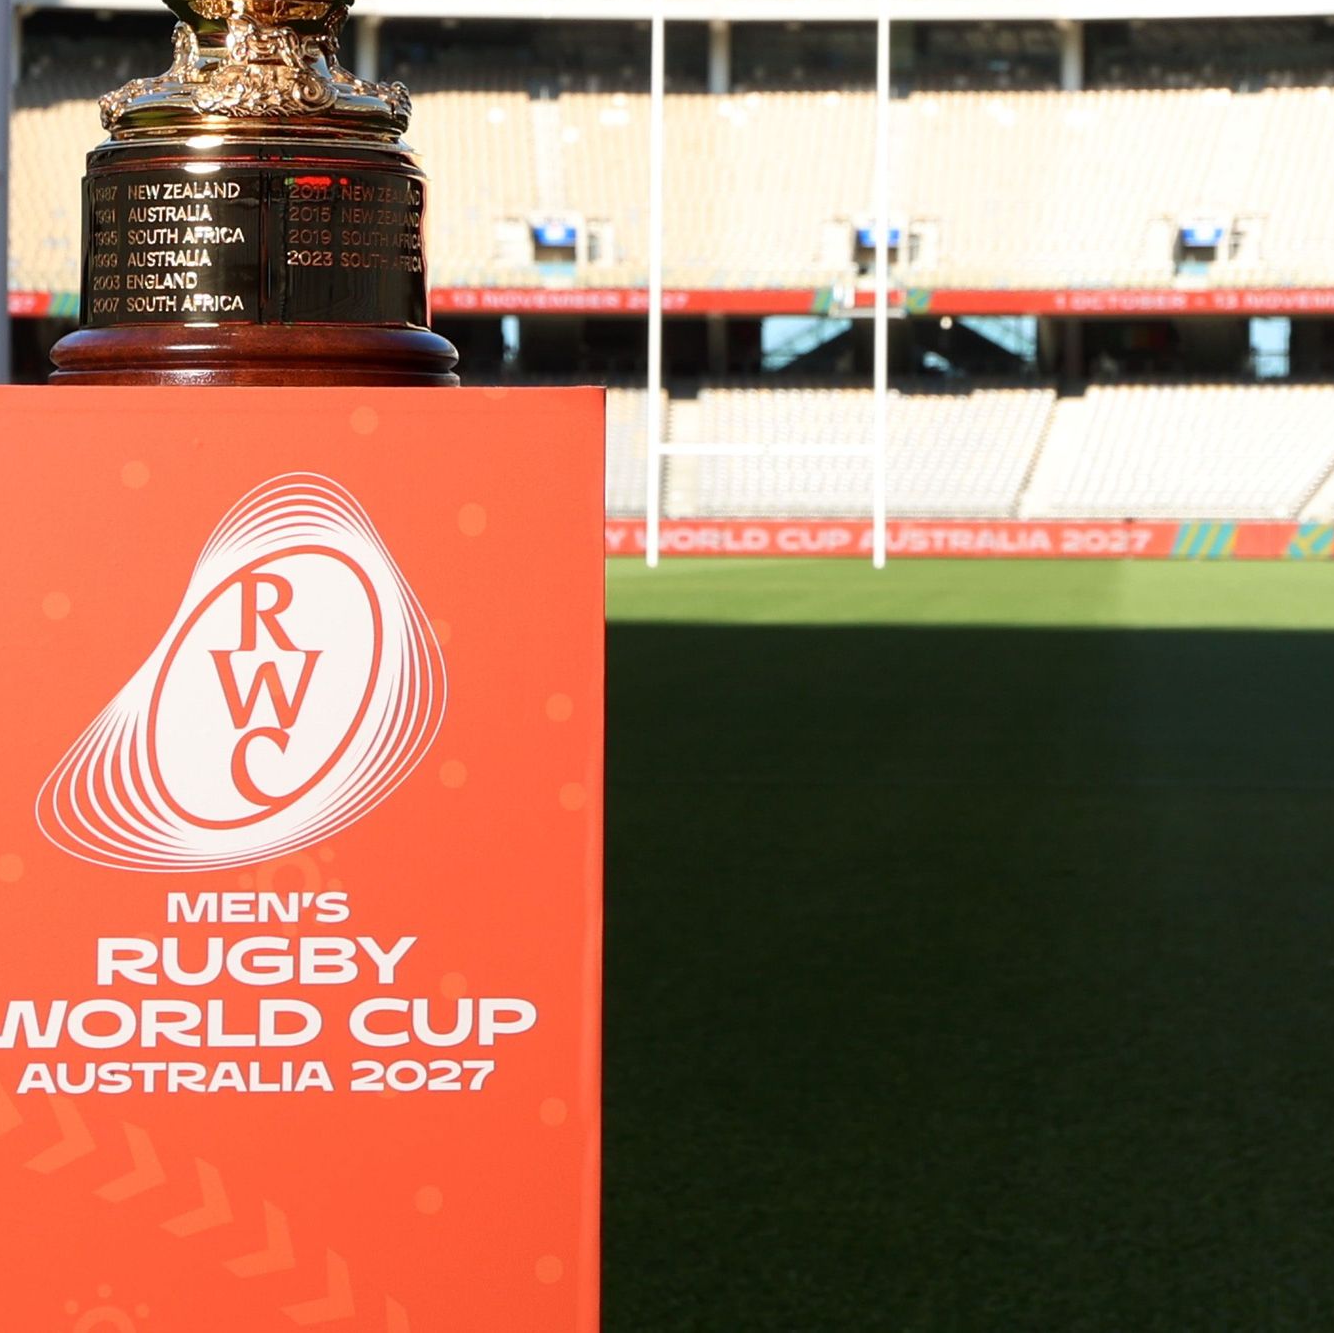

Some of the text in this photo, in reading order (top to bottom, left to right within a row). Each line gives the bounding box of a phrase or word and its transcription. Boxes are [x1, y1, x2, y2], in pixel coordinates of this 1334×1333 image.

[93, 181, 241, 202] 1987 NEW ZEALAND
[288, 184, 328, 200] 2011
[340, 185, 374, 202] NEW
[93, 204, 213, 224] 1991 AUSTRALIA
[288, 206, 421, 228] 2015 NEW ZEALAND
[93, 226, 245, 246] 1995 SOUTH AFRICA
[288, 229, 422, 250] 2019 SOUTH AFRICA
[93, 249, 213, 268] 1999 AUSTRALIA
[287, 249, 423, 273] 2023 SOUTH AFRICA
[93, 271, 198, 291] 2003 ENGLAND
[92, 294, 244, 313] 2007 SOUTH AFRICA
[634, 527, 768, 551] WORLD
[777, 527, 853, 551] CUP
[859, 529, 1054, 553] AUSTRALIA
[1061, 529, 1153, 553] 2027
[167, 891, 350, 923] MEN'S
[96, 935, 419, 986] RUGBY
[348, 997, 538, 1047] CUP
[15, 1059, 496, 1095] AUSTRALIA 2027
